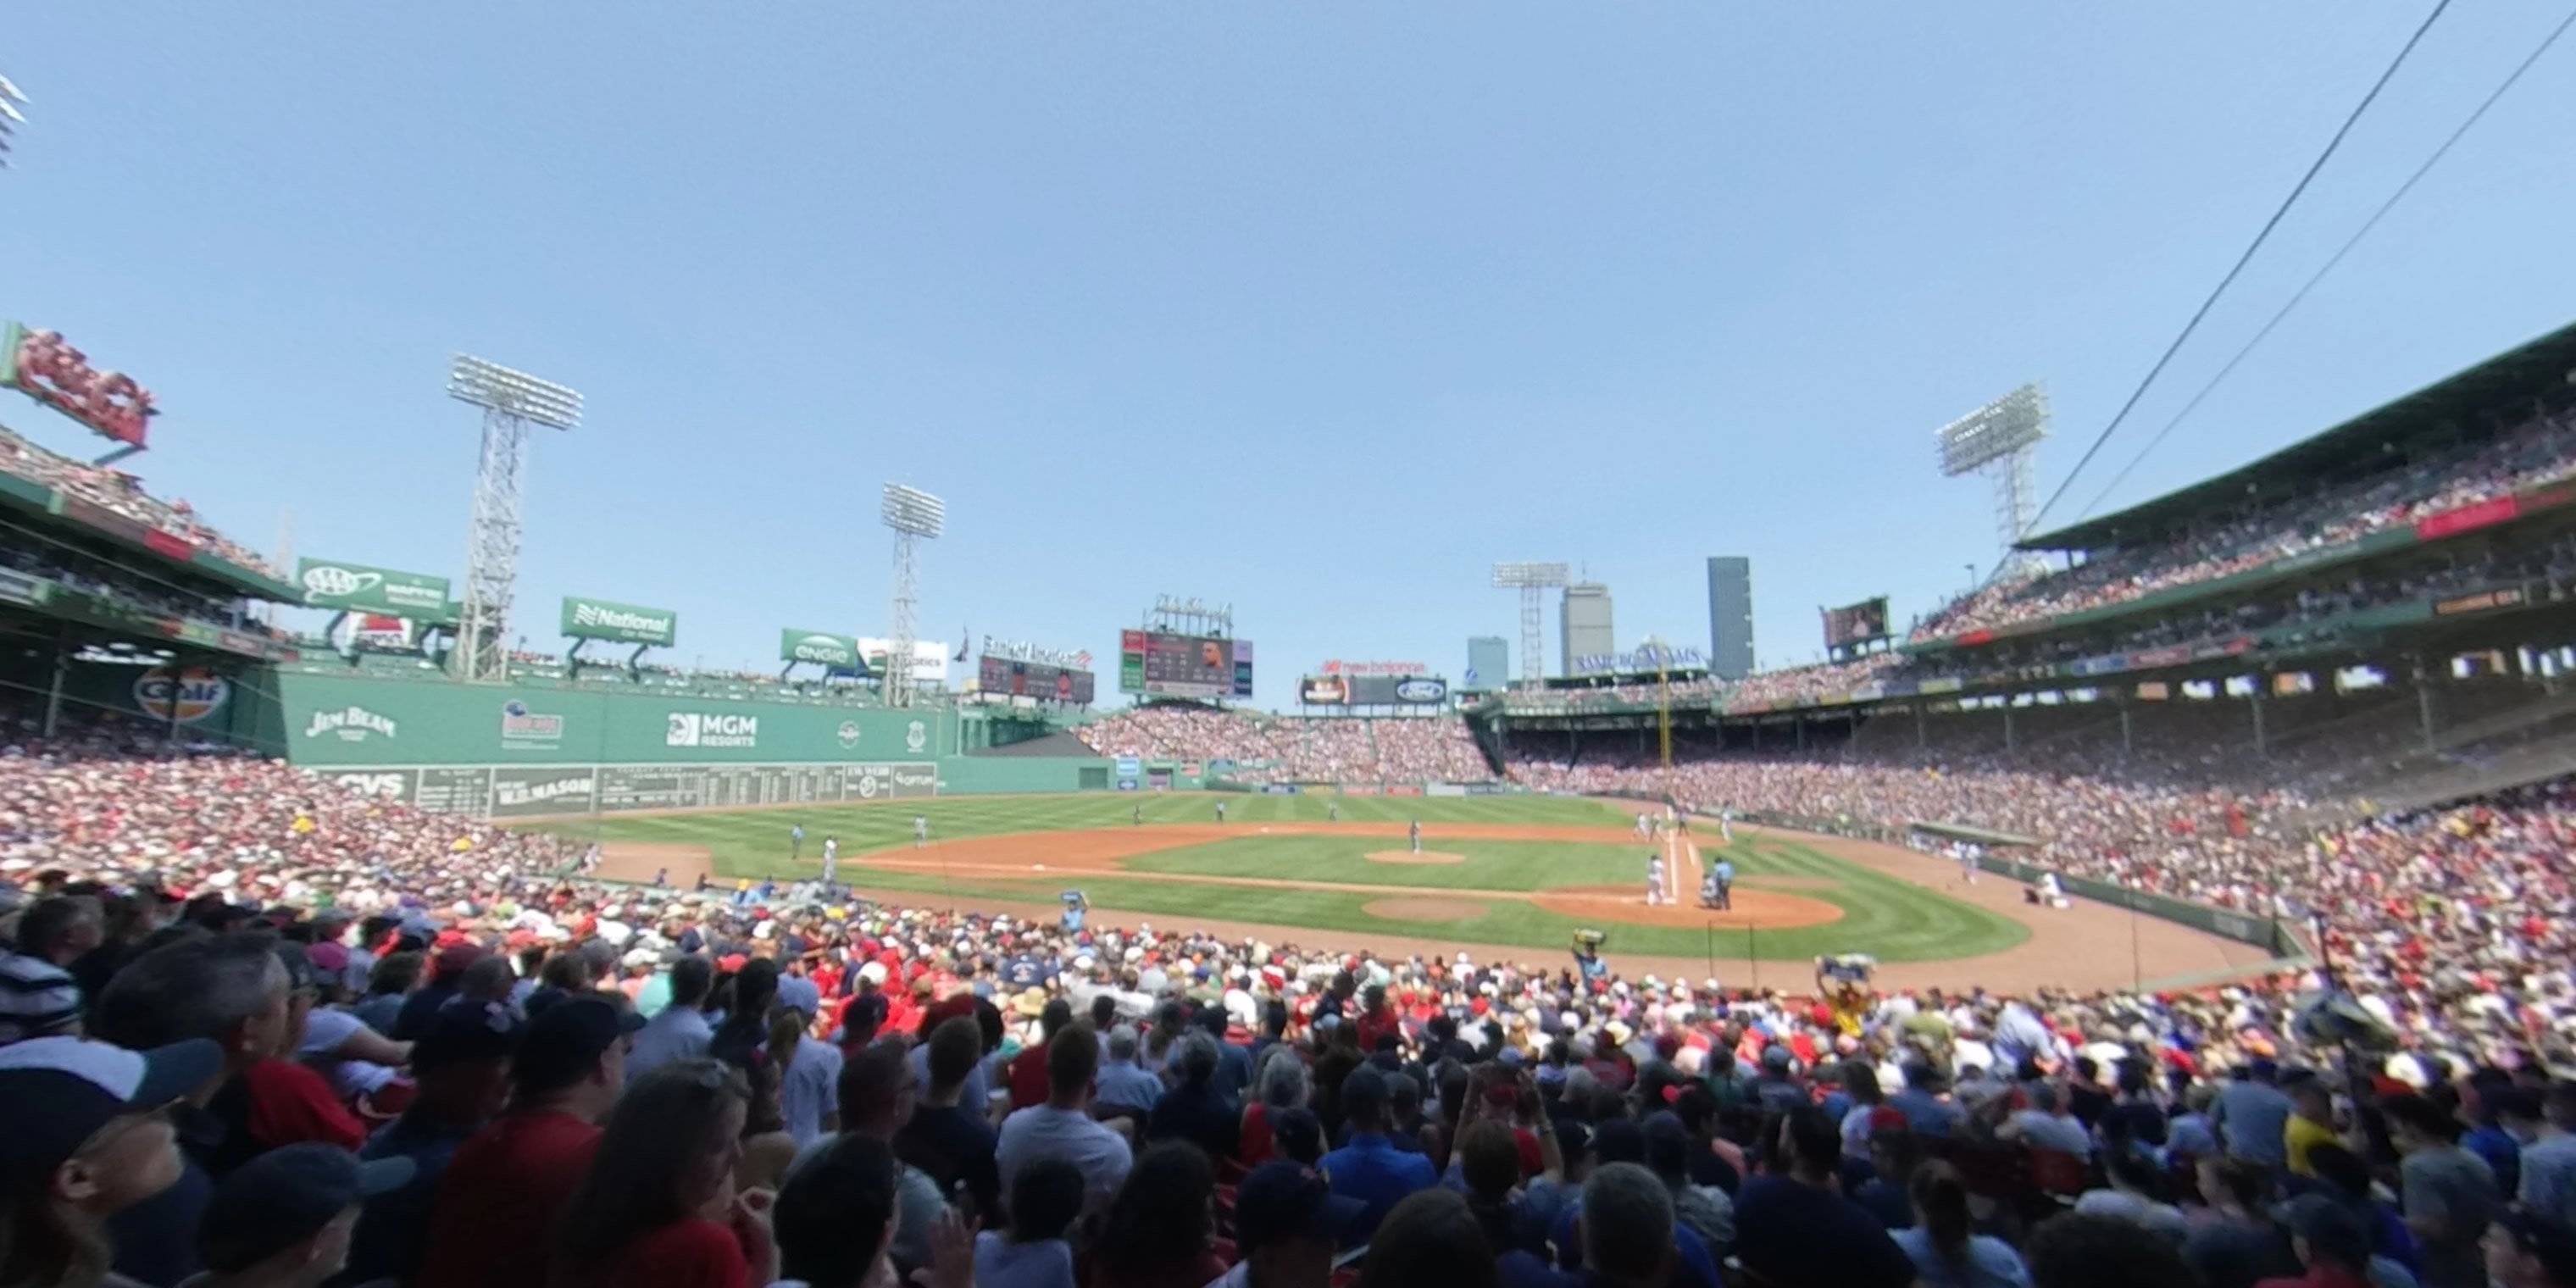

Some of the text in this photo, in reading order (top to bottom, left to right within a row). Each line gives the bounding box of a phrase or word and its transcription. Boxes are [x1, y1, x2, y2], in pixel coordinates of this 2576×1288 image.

[597, 607, 669, 632] National
[1343, 663, 1367, 672] new
[1369, 661, 1424, 673] balance
[346, 706, 396, 738] BEAM
[702, 715, 758, 735] MGM
[701, 735, 756, 747] RESORTS
[531, 778, 591, 798] MASON
